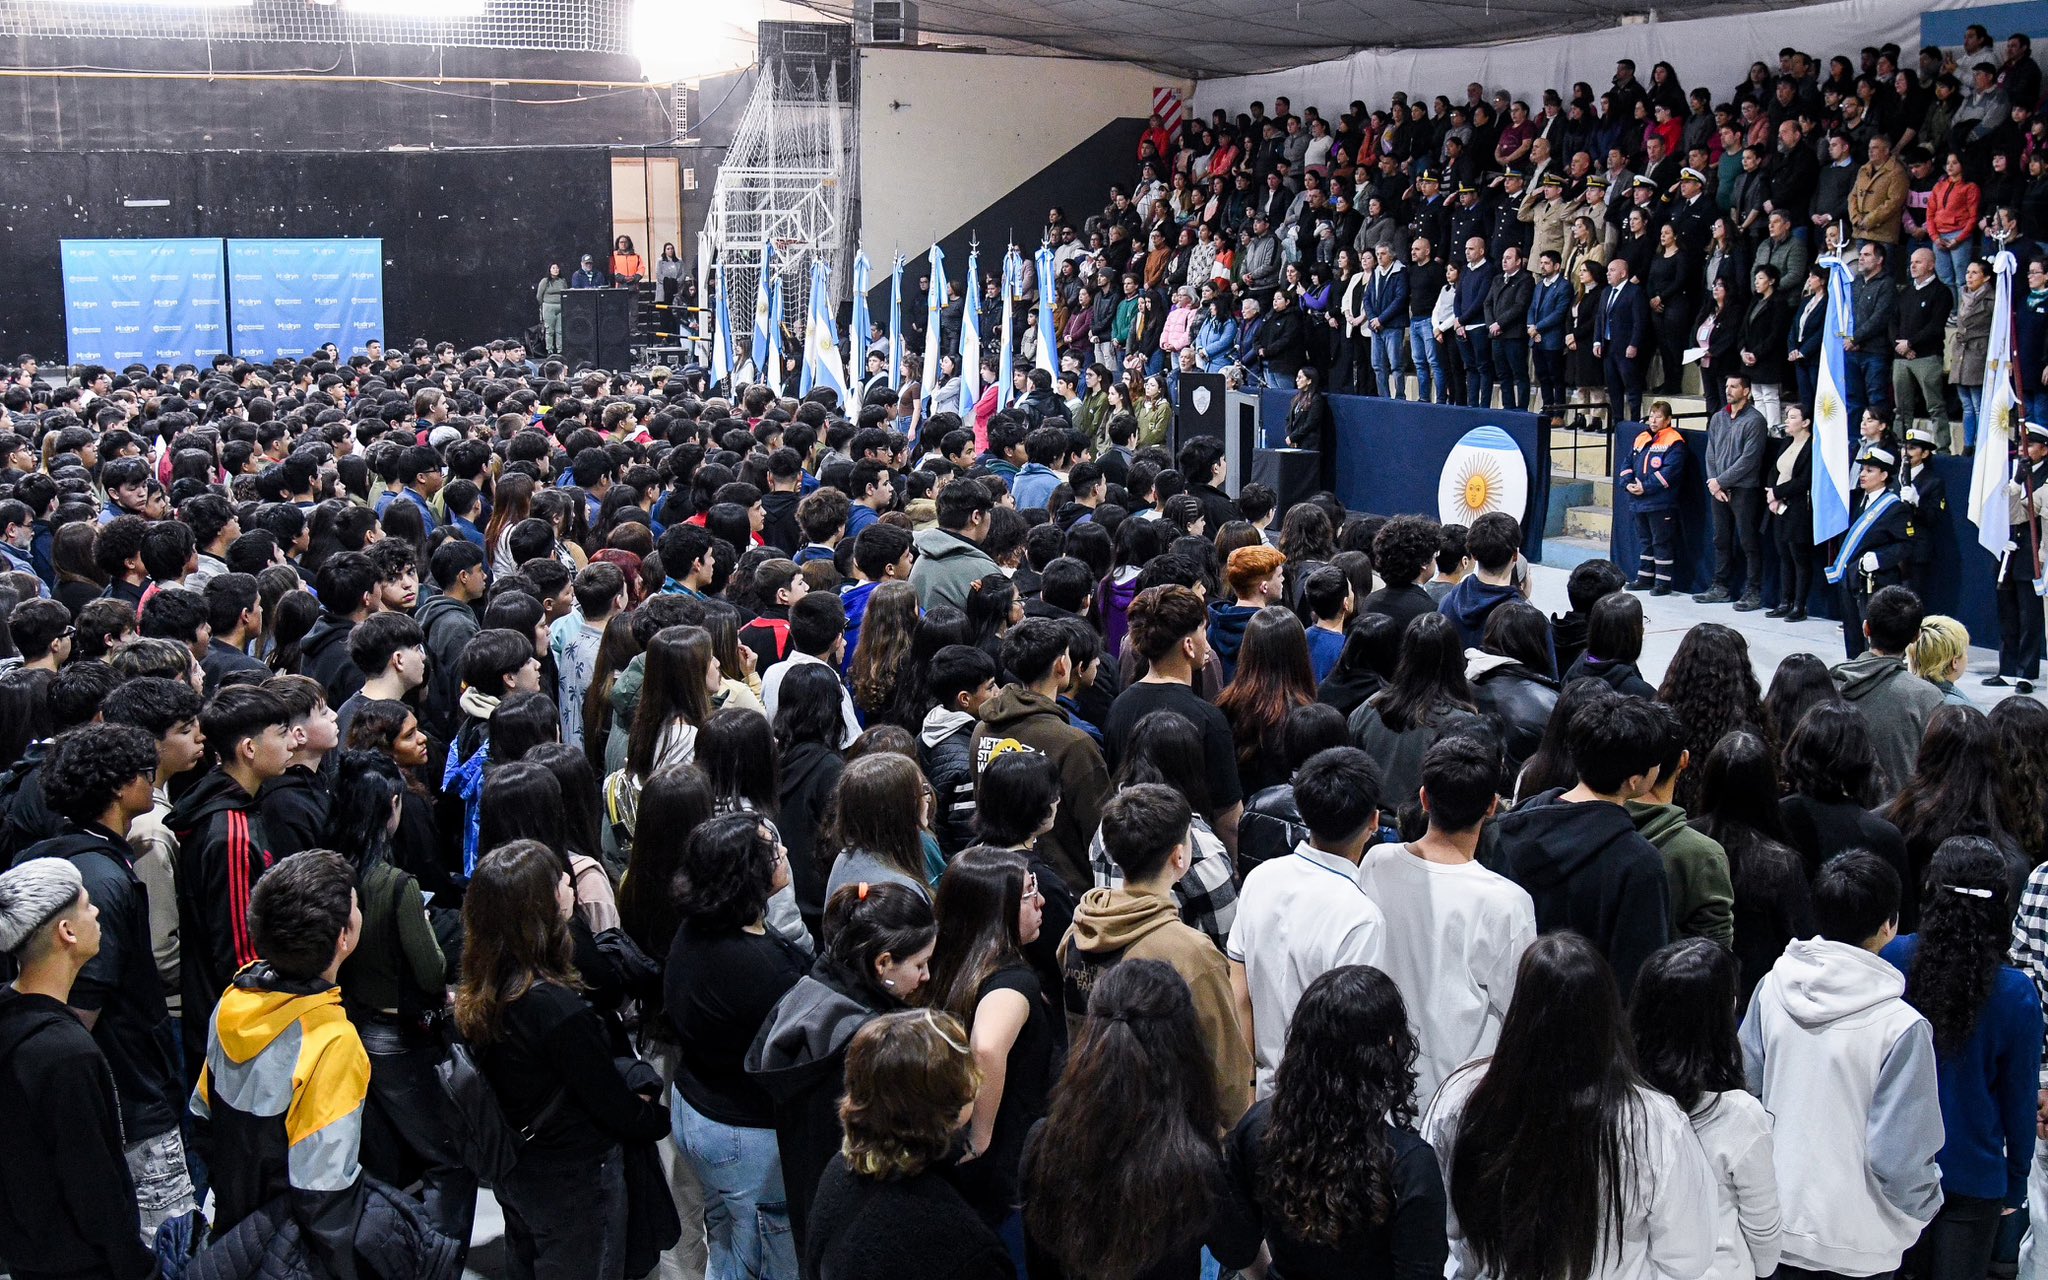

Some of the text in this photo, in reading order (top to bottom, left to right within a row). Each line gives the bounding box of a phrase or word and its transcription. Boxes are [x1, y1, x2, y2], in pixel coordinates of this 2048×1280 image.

[69, 249, 96, 257] Mdryn
[150, 248, 176, 257] Mdryn
[235, 248, 260, 256] Mdryn
[312, 247, 336, 256] Mdryn
[977, 761, 989, 773] W
[1064, 967, 1096, 981] NORT
[1076, 979, 1095, 992] FAC
